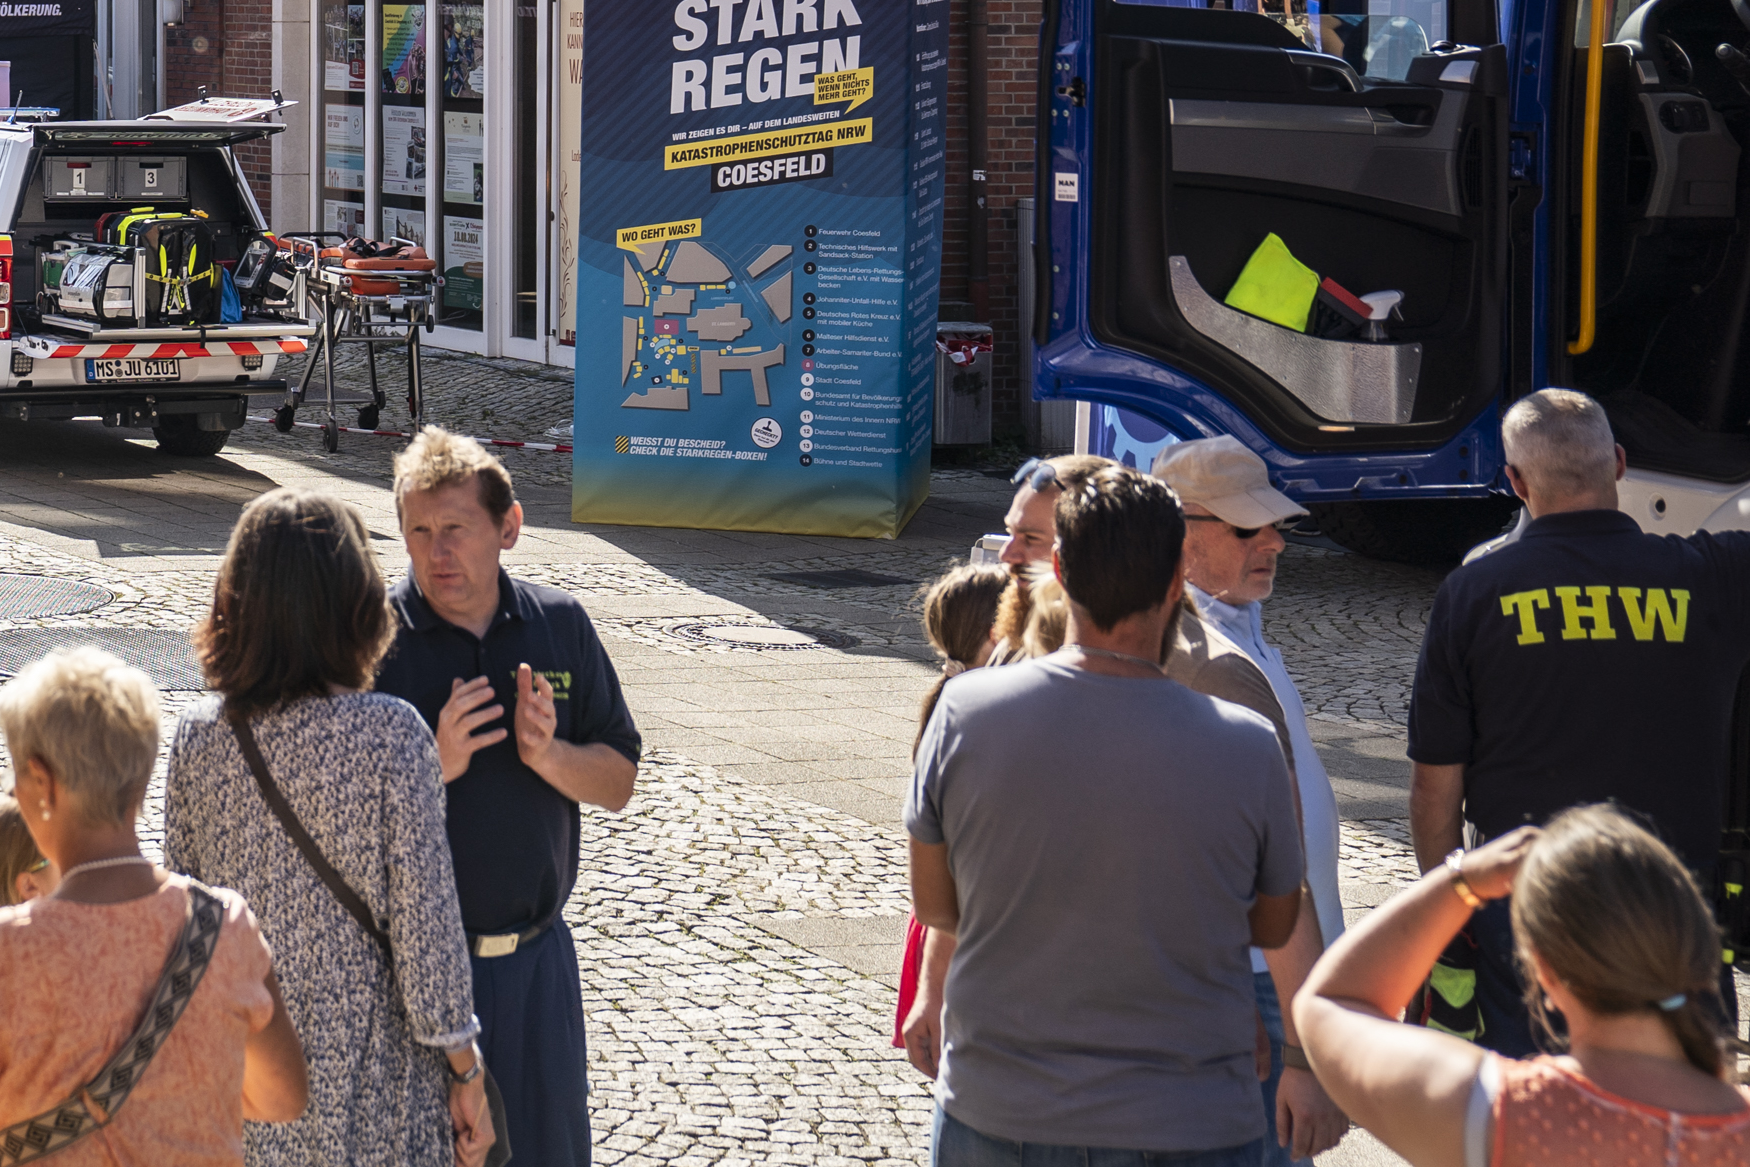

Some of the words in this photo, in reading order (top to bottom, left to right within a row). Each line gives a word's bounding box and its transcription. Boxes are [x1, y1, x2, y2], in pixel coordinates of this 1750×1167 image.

[670, 35, 861, 115] REGEN
[818, 76, 836, 85] WAS
[837, 73, 858, 84] GEHT,
[818, 83, 841, 93] WENN
[842, 79, 870, 90] NICHTS
[818, 92, 840, 101] MEHR
[842, 88, 866, 98] GEHT?
[672, 132, 687, 141] WIR
[688, 128, 715, 139] ZEIGEN
[716, 126, 726, 134] ES
[728, 124, 741, 133] DIR
[748, 121, 763, 131] AUF
[764, 118, 782, 128] DEM
[783, 110, 840, 126] LANDESWEITEN
[671, 128, 833, 163] KATASTROPHENSCHUTZTAG
[836, 124, 867, 140] NRW
[717, 153, 826, 188] COESFELD
[76, 172, 82, 184] 1
[147, 172, 155, 184] 3
[622, 231, 638, 242] WO
[640, 227, 666, 240] GEHT
[668, 223, 696, 236] WAS?
[818, 251, 874, 259] Sandsack-Station
[817, 297, 886, 305] Johanniter-Unfall-Hilfe
[816, 348, 890, 357] Arbeiter-Samariter-Bund
[96, 361, 113, 377] MS
[124, 360, 141, 376] JU
[815, 362, 858, 370] Übungsfläche
[847, 430, 886, 438] Wetterdienst
[630, 436, 663, 446] WEISST
[664, 438, 677, 447] DU
[678, 439, 726, 449] BESCHEID?
[814, 443, 861, 451] Bundesverband
[630, 446, 658, 455] CHECK
[660, 447, 674, 456] DIE
[676, 448, 768, 461] STARKREGEN-BOXEN!
[1500, 586, 1691, 646] THW
